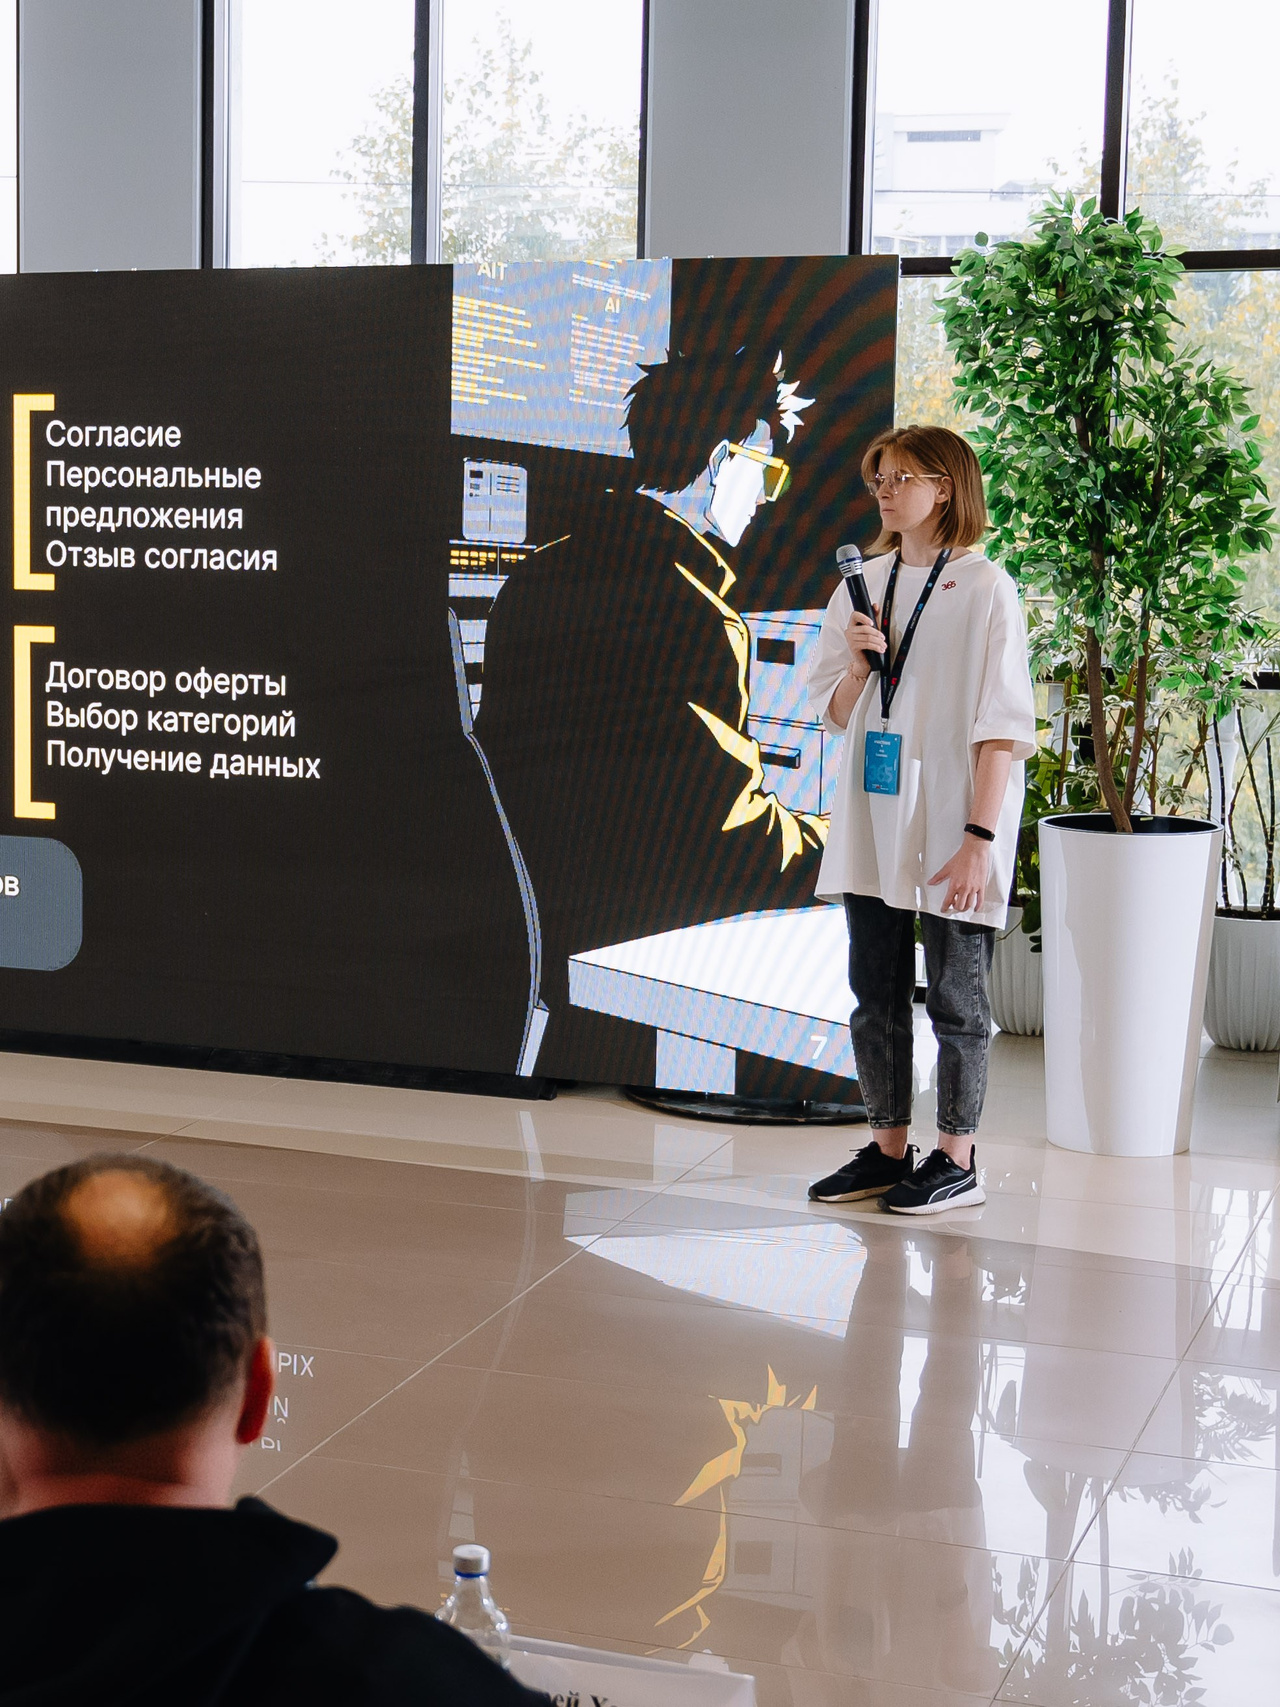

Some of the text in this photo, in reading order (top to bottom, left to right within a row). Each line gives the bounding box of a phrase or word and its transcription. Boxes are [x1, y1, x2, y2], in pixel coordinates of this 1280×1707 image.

[45, 419, 182, 448] Согласие
[46, 459, 262, 493] Персональные
[46, 505, 243, 534] предложения
[45, 539, 278, 572] Отзыв согласия
[44, 660, 287, 702] Договор оферты
[46, 700, 296, 742] Выбор категорий
[47, 739, 321, 780] Получение данных
[810, 1035, 828, 1060] 7
